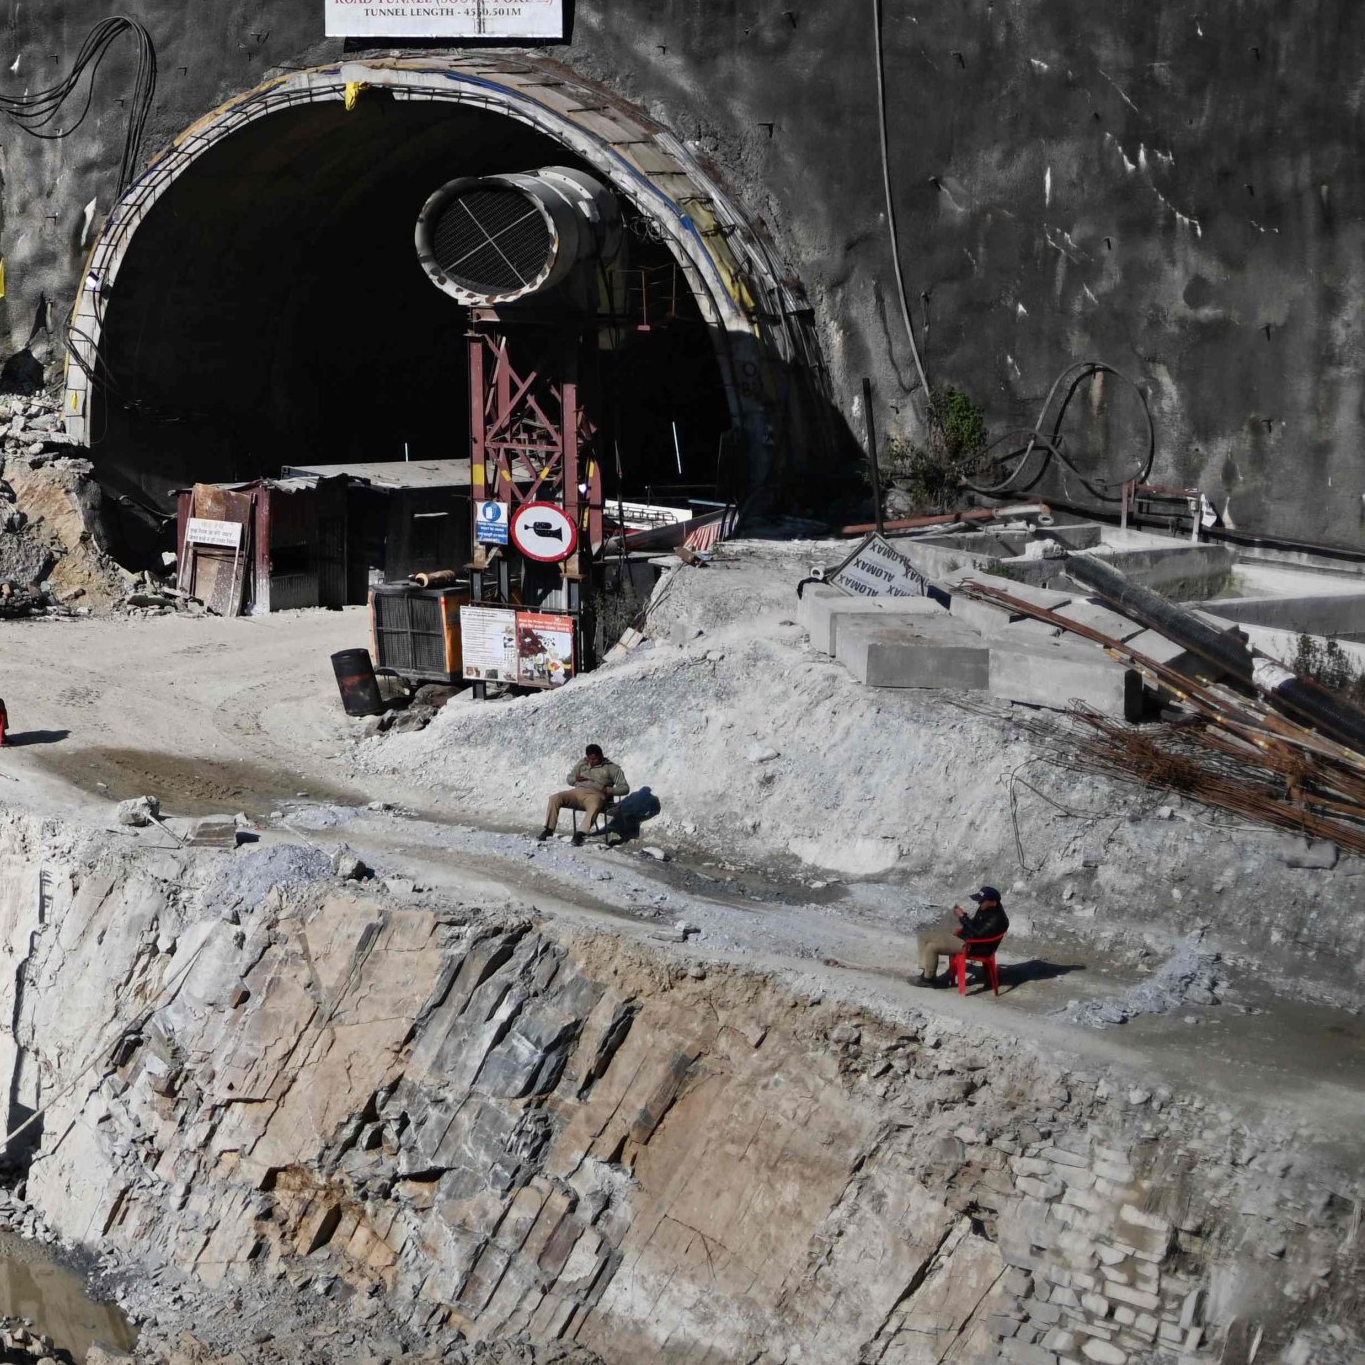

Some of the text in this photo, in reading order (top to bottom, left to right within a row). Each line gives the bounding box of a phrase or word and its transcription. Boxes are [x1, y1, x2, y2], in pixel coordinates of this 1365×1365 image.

[364, 8, 407, 17] TUNNEL
[410, 7, 454, 16] LENGTH
[853, 558, 896, 583] ALOMAX
[837, 574, 880, 597] ALOMAX
